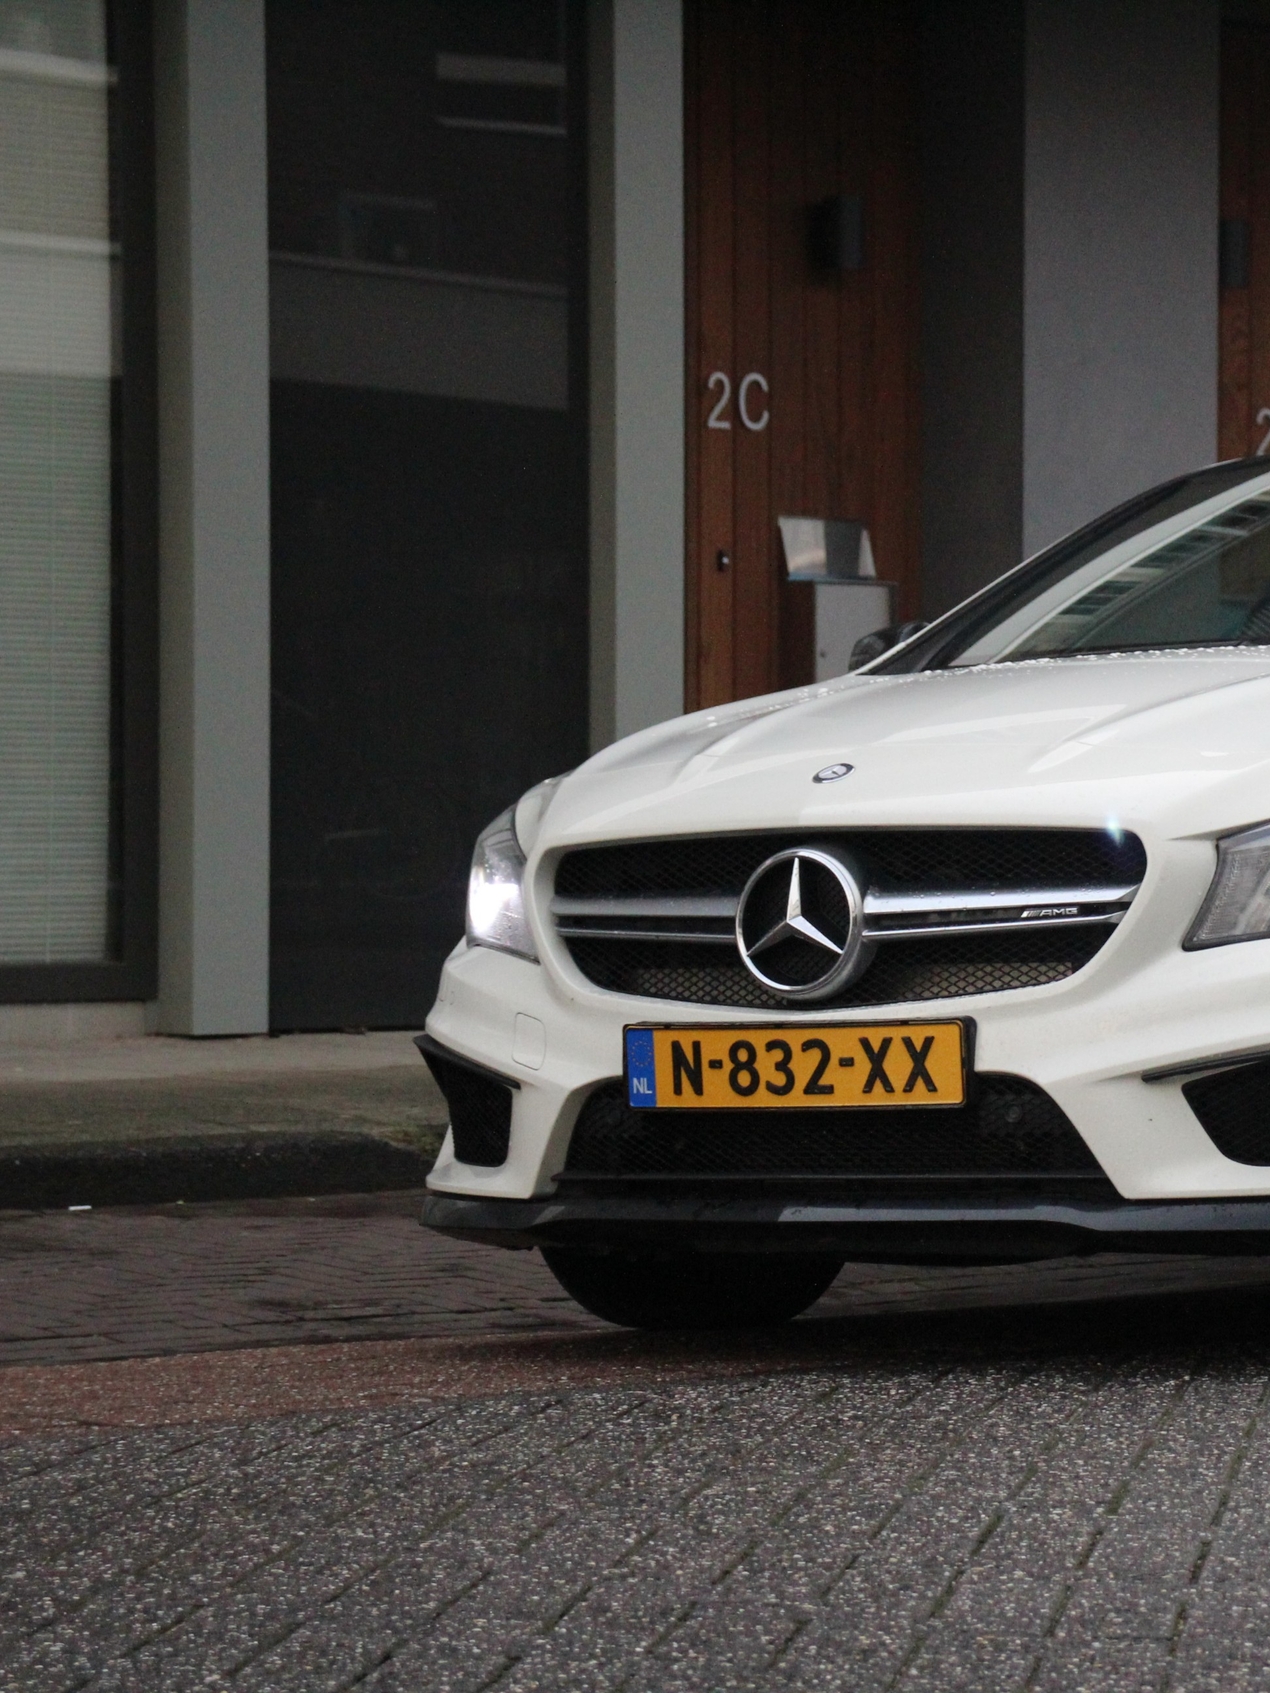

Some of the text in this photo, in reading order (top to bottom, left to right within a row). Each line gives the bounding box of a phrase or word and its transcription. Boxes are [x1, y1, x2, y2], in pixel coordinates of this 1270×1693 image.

[707, 371, 770, 432] 2C
[1037, 907, 1079, 917] AMG
[632, 1077, 653, 1094] NL
[671, 1035, 938, 1097] N-832-XX
